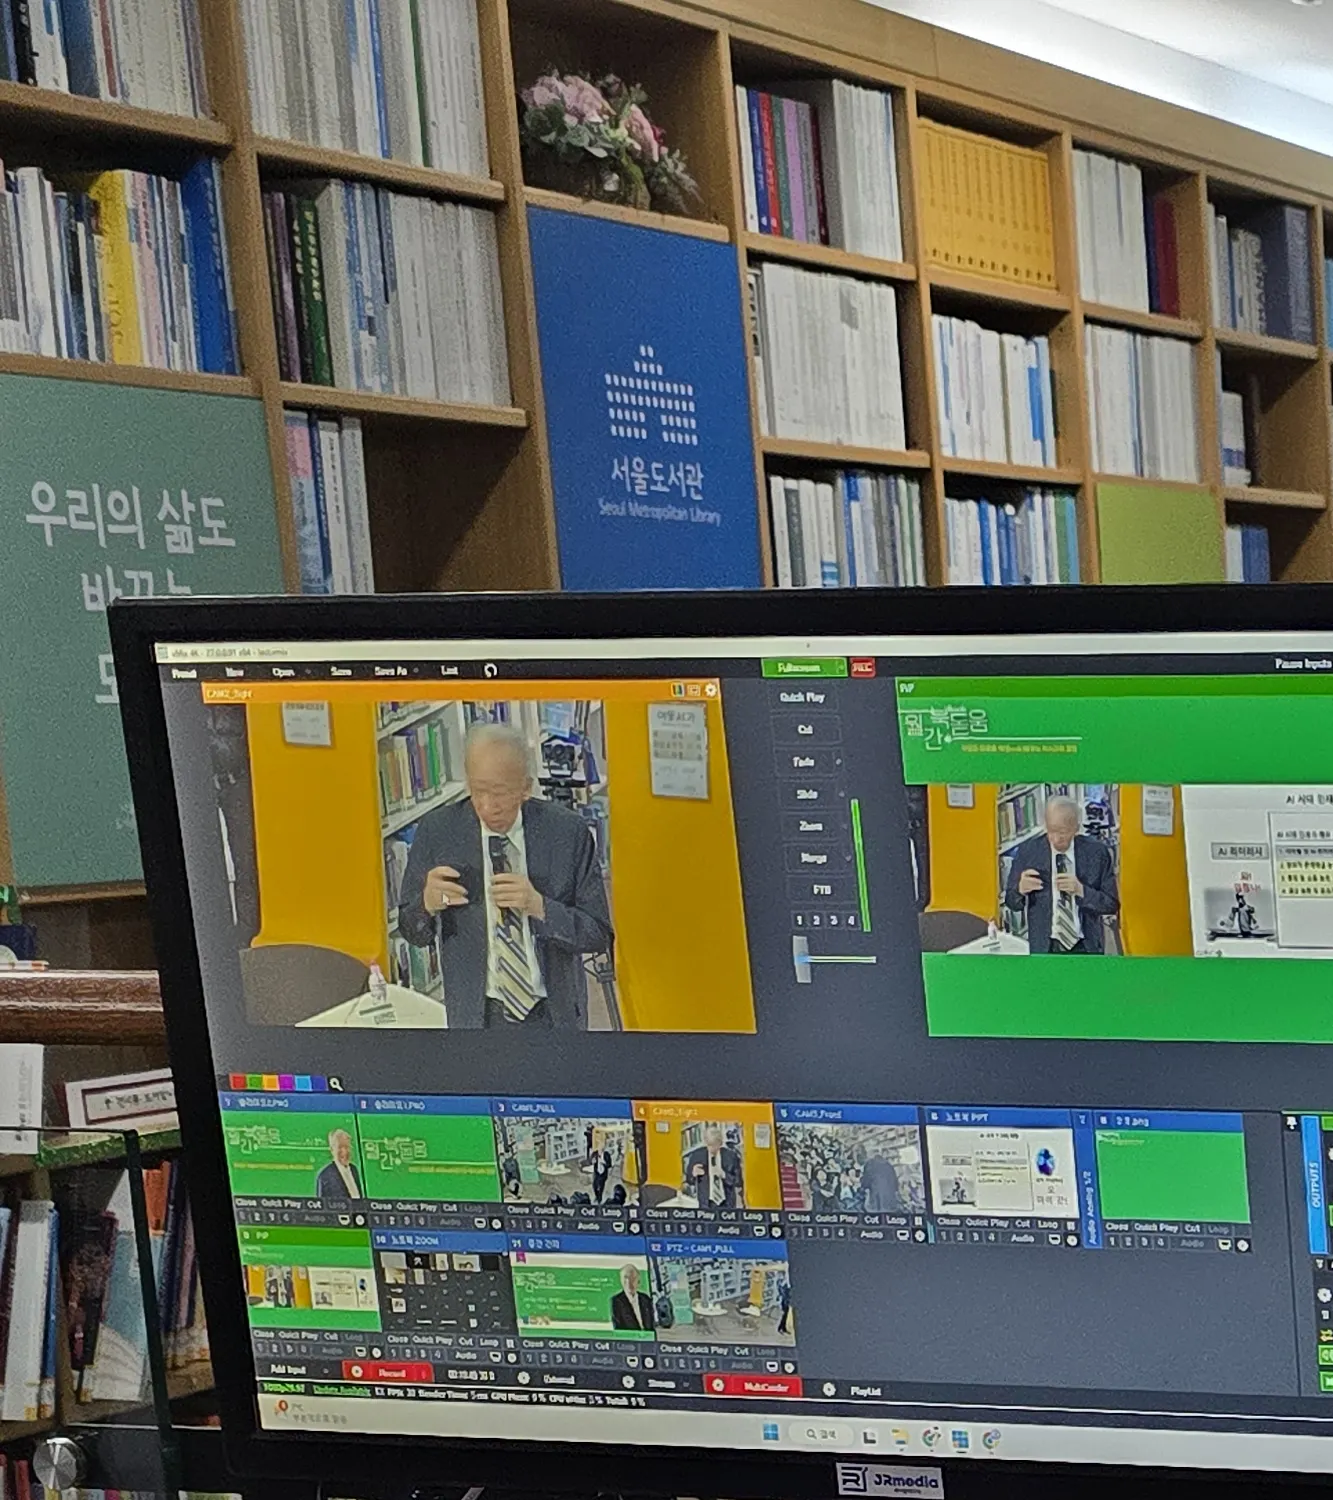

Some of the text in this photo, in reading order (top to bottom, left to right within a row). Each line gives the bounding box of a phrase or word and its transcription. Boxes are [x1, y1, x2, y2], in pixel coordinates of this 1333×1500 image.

[611, 456, 704, 500] 서울도서관
[26, 481, 236, 553] 우리의 삶도
[598, 498, 721, 527] Seoul Metropolitan Library
[852, 662, 873, 673] REC
[1275, 658, 1302, 670] Pause
[272, 667, 295, 679] Open
[780, 691, 826, 705] Quick Play
[798, 725, 814, 735] Cut
[1310, 1161, 1322, 1209] OUTPUTS
[850, 1385, 882, 1398] PlayList
[873, 1473, 940, 1489] JRmedia
